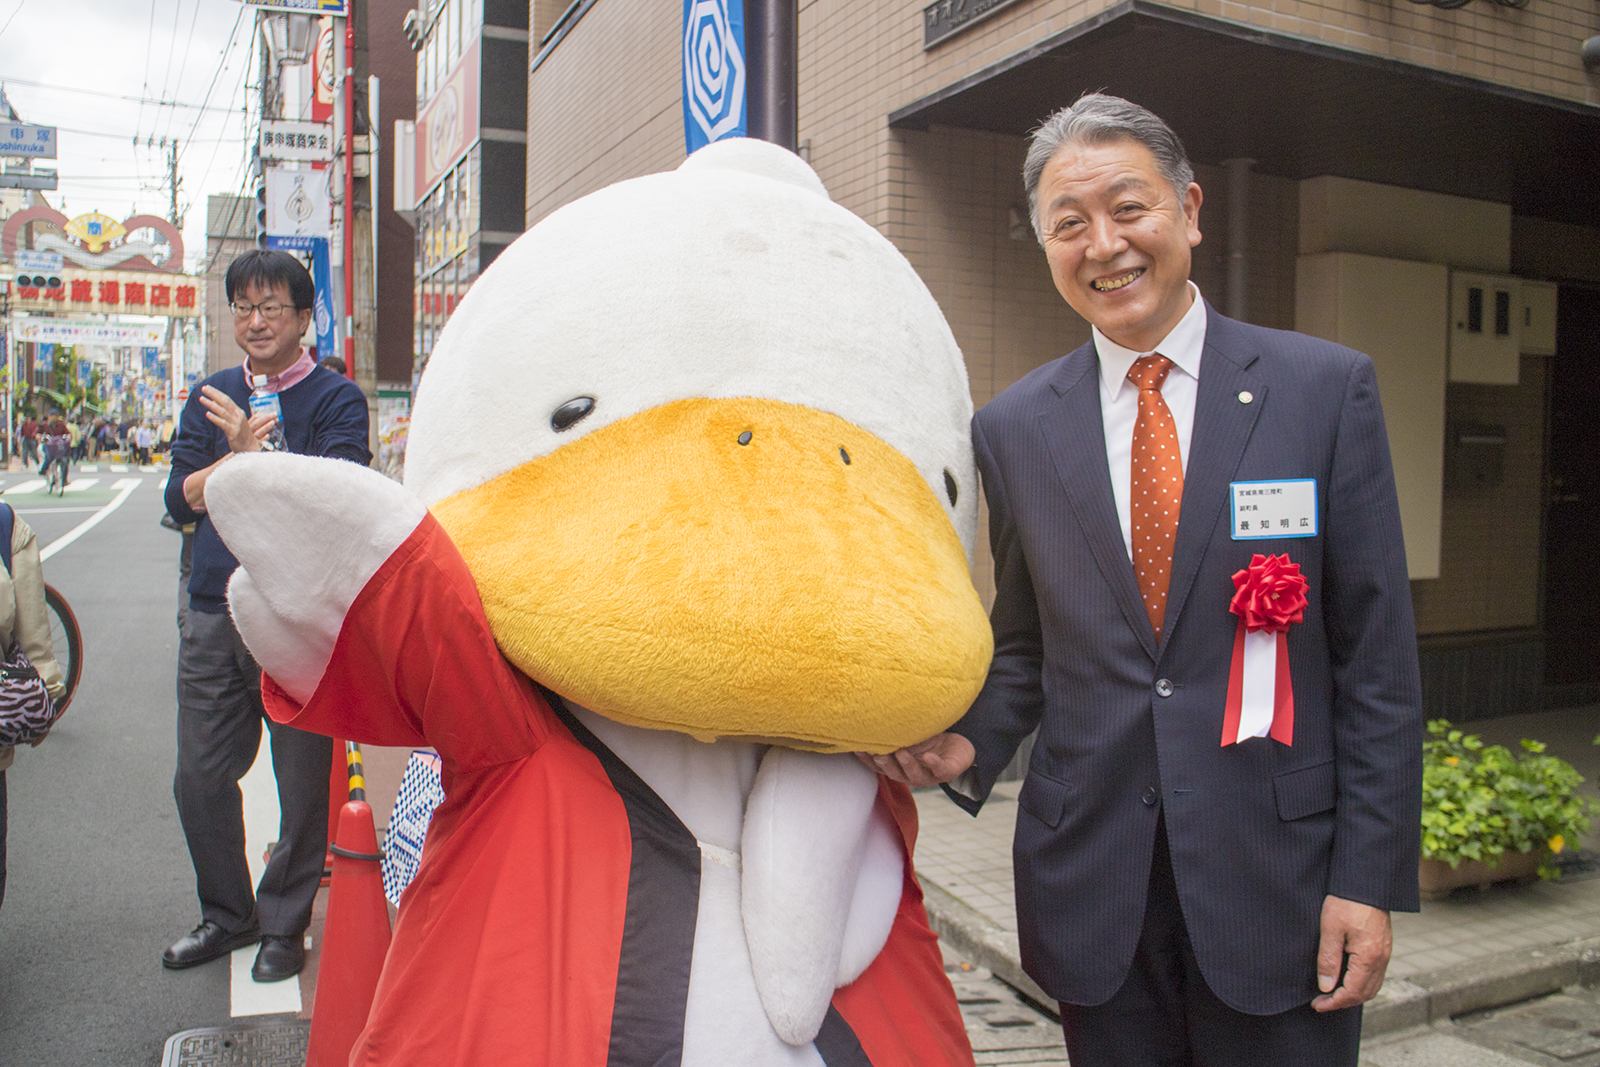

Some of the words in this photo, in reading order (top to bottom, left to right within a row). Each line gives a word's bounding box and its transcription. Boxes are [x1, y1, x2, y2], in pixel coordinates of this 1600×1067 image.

[263, 131, 328, 149] 庚申塚商栄会
